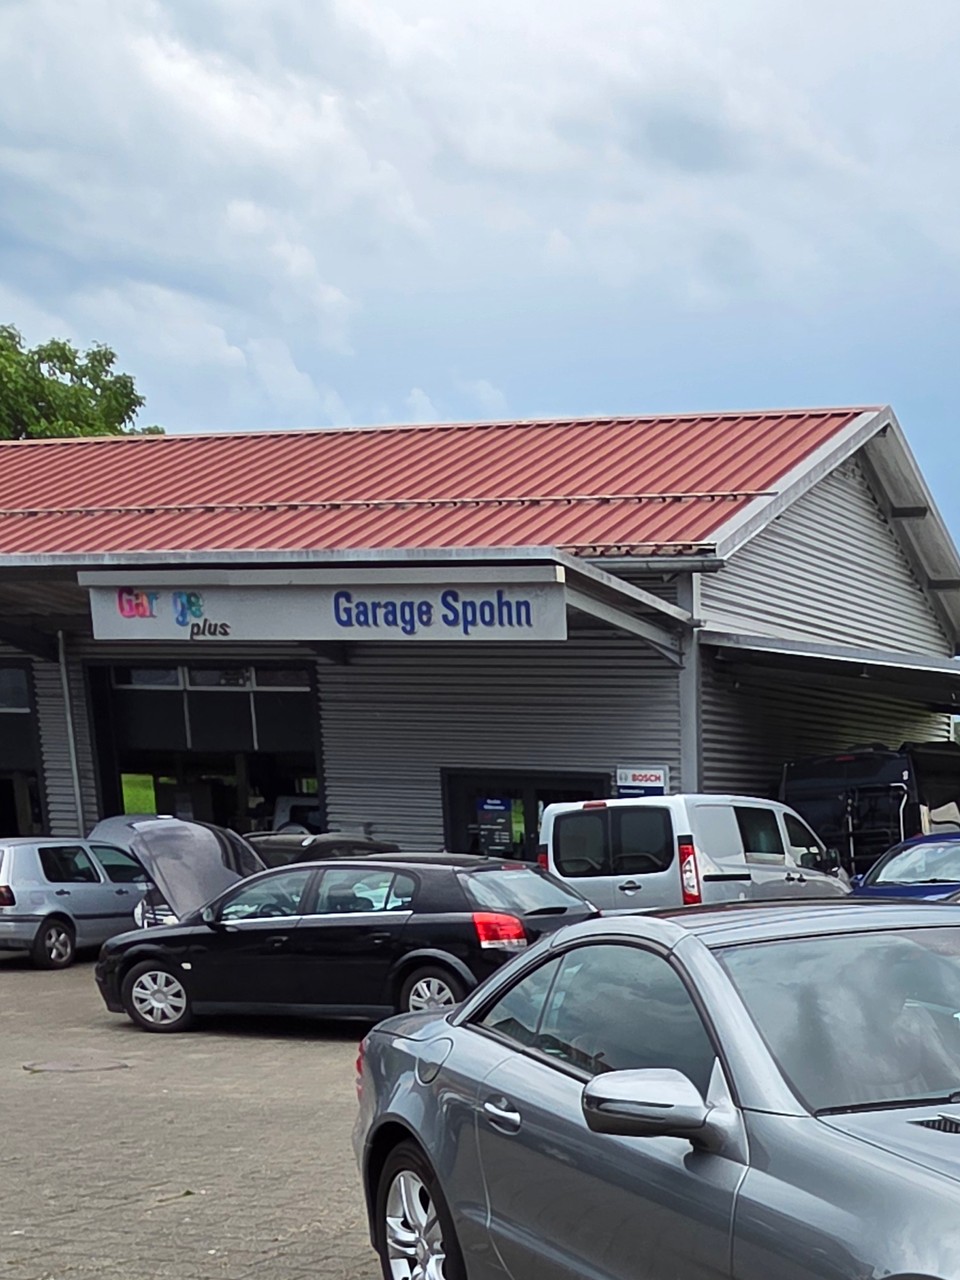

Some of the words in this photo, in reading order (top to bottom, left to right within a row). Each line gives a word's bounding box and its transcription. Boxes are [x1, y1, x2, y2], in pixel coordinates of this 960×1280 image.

[117, 586, 204, 627] Garge
[333, 590, 434, 636] Garage
[440, 589, 532, 636] Spohn
[189, 618, 231, 640] plus
[632, 773, 661, 783] BOSCH
